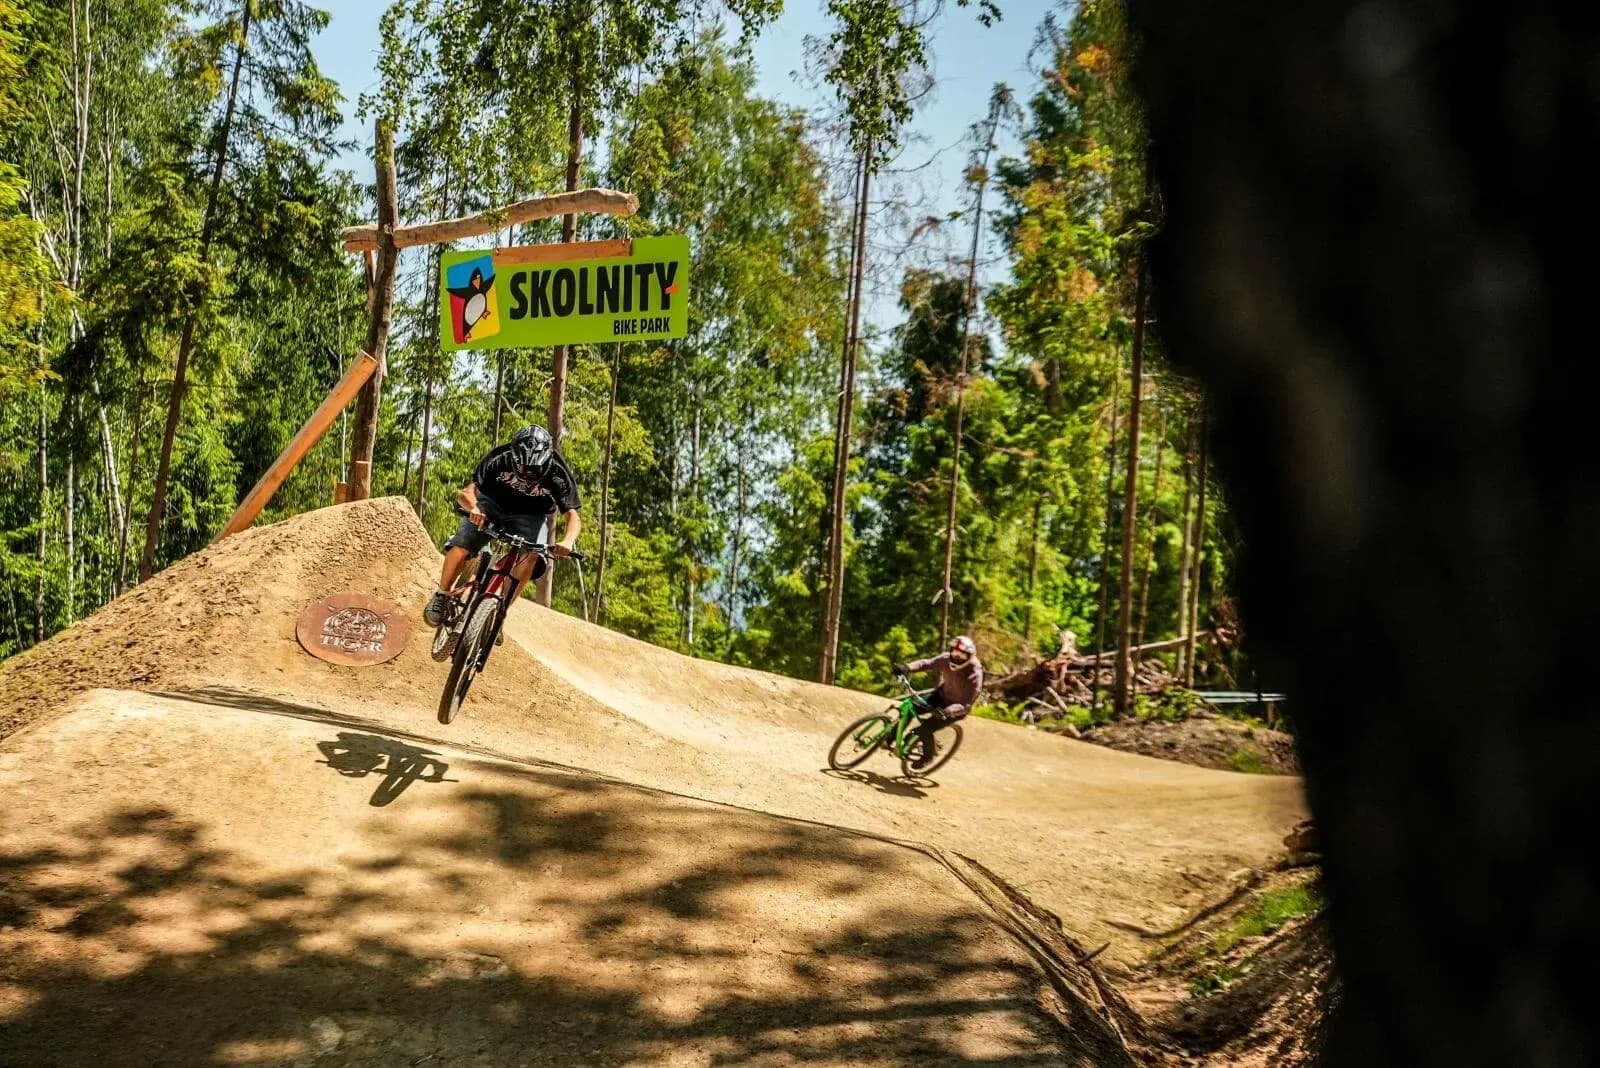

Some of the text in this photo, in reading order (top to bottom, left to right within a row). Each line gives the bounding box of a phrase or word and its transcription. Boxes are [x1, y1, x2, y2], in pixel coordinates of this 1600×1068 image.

[509, 261, 679, 321] SKOLNITY
[613, 316, 671, 335] BIKE PARK
